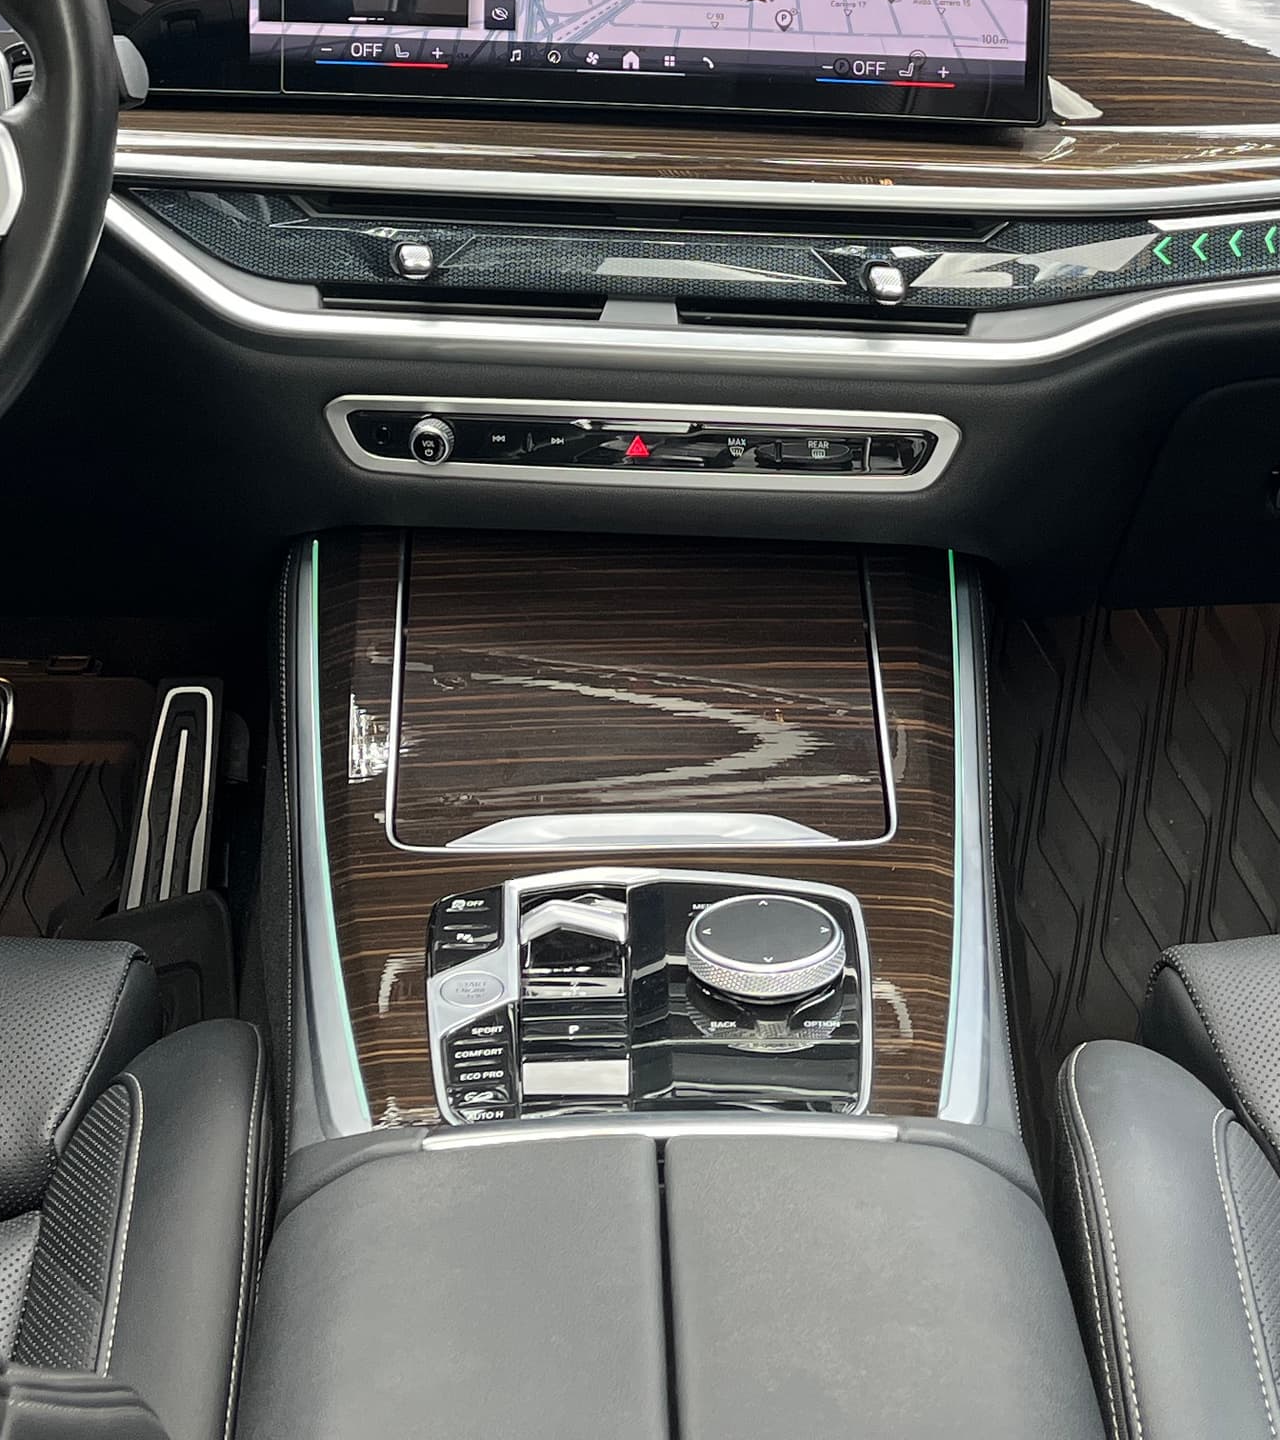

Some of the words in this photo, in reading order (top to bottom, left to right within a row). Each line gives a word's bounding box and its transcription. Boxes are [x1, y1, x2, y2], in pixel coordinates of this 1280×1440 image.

[350, 43, 384, 58] OFF
[852, 60, 887, 76] OFF
[422, 439, 436, 448] VOL
[727, 437, 747, 447] MAX
[807, 440, 830, 449] REAR
[466, 899, 485, 907] OFF
[710, 1020, 737, 1029] BACK
[803, 1020, 841, 1029] OPTION
[471, 1025, 504, 1035] SPORT
[454, 1047, 504, 1059] COMFORT
[459, 1072, 481, 1082] ECO
[482, 1070, 504, 1080] PRO
